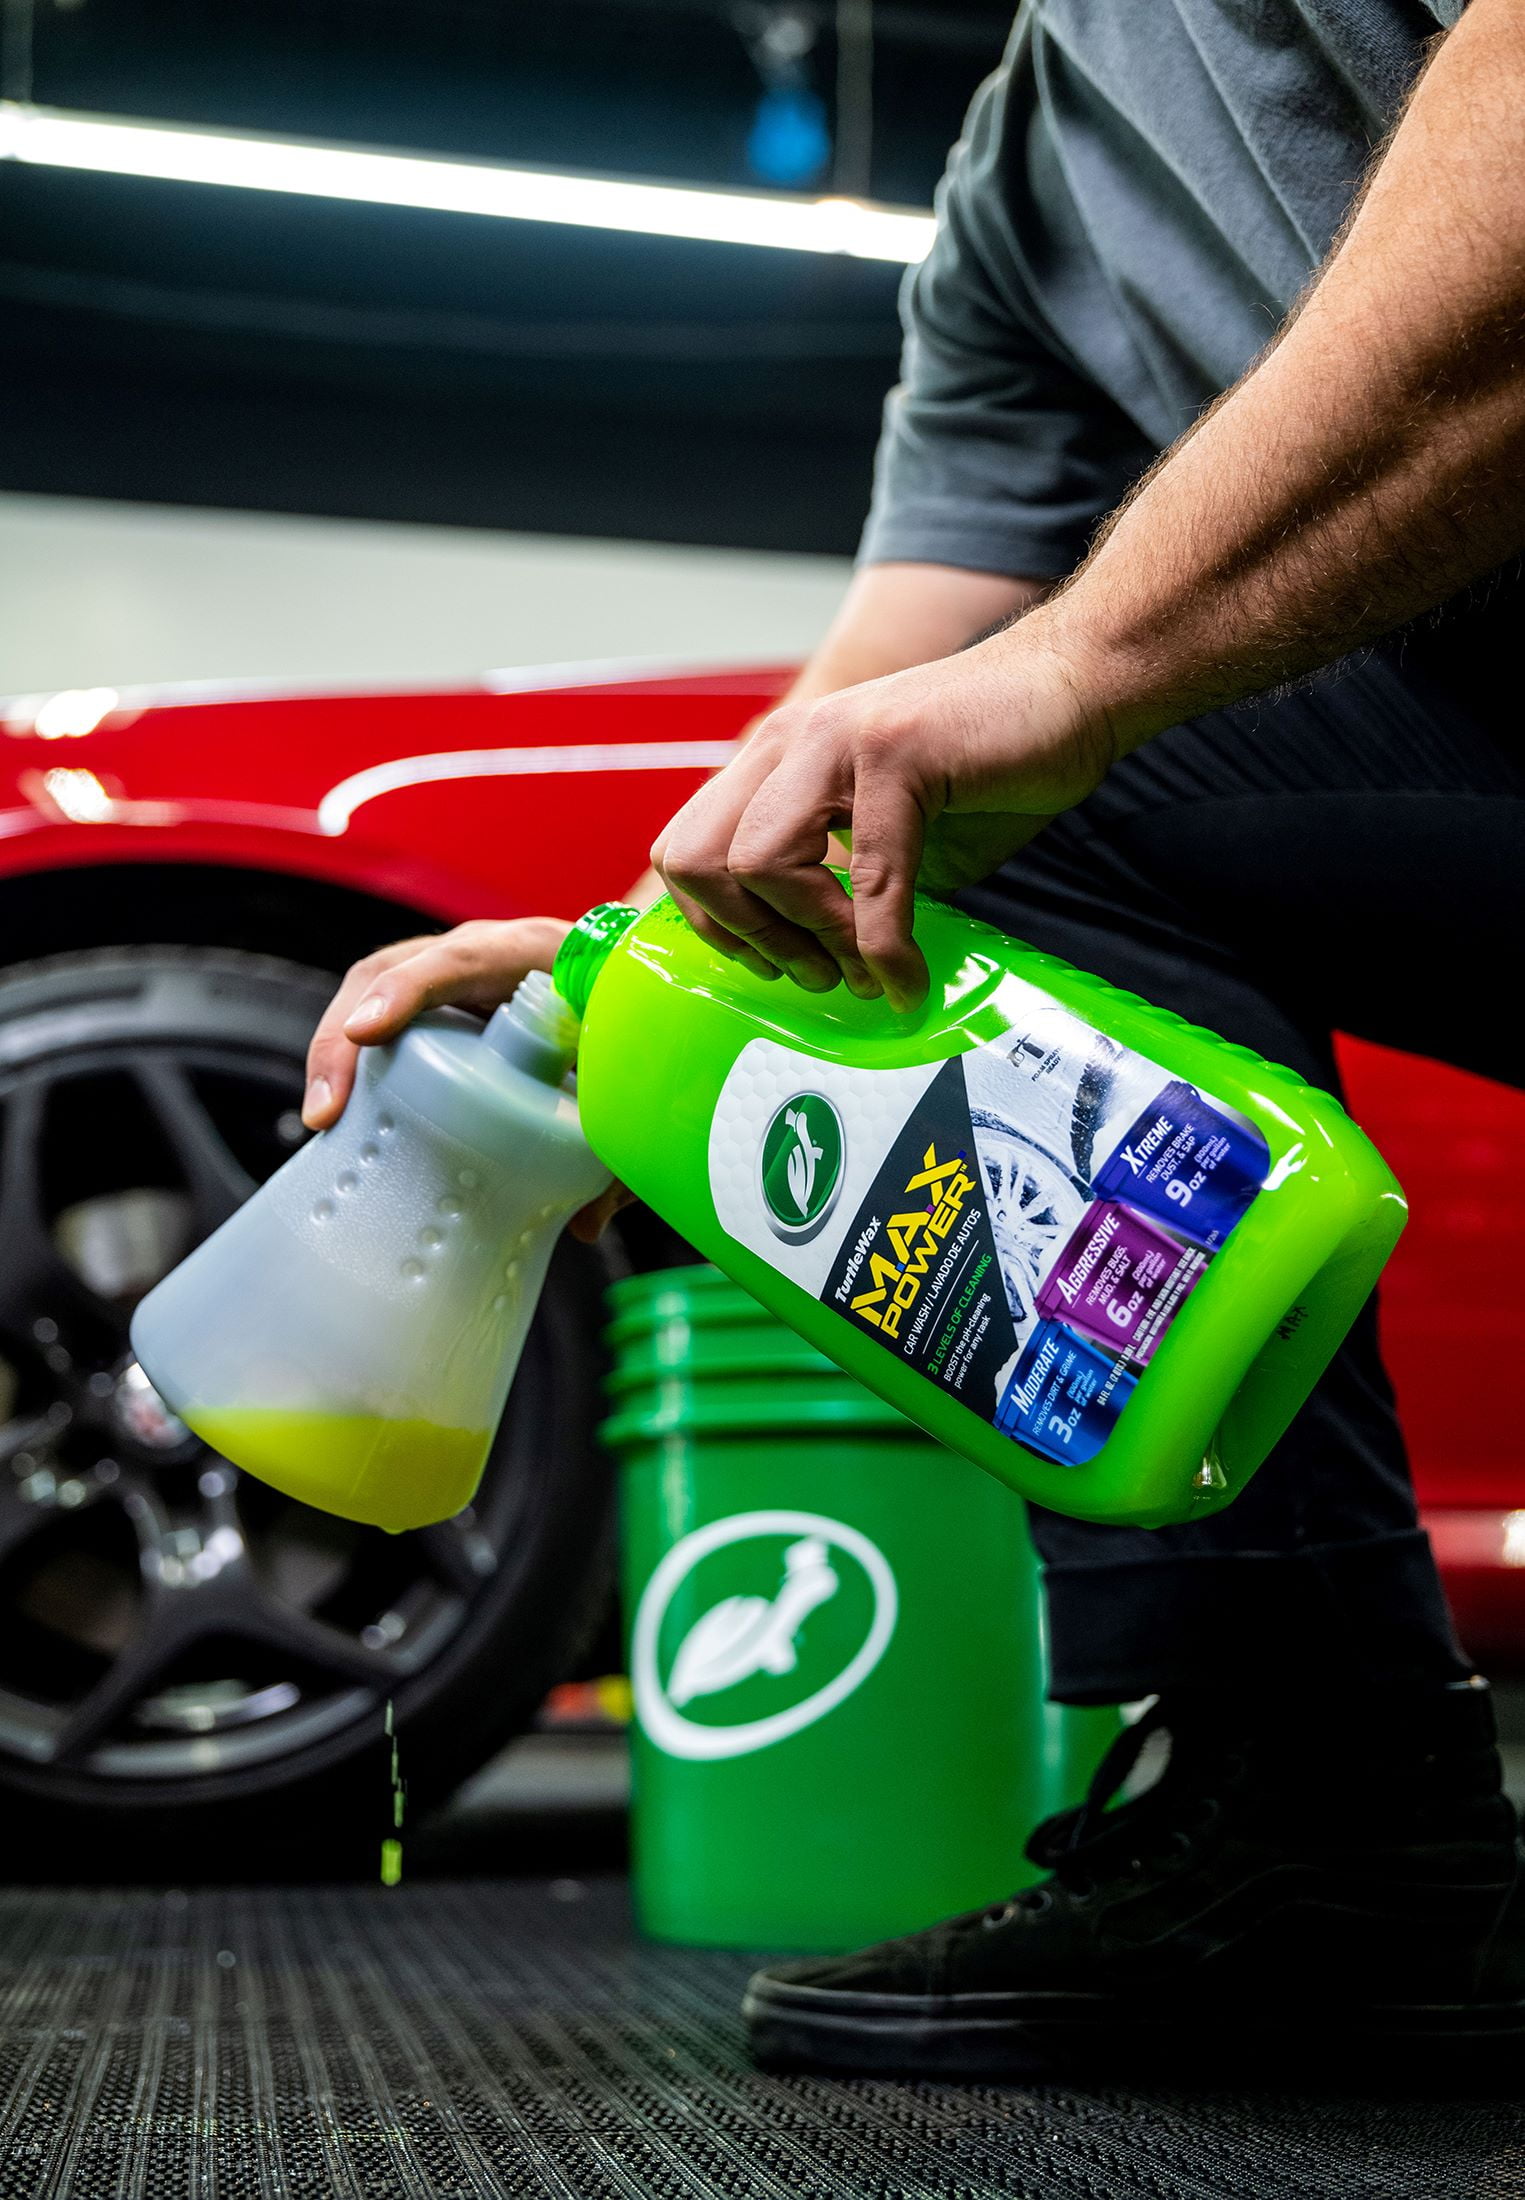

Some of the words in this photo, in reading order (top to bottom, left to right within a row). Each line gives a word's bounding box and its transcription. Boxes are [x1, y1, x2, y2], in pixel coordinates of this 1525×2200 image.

[1045, 1056, 1061, 1074] READY
[1119, 1115, 1173, 1175] XTREME
[1145, 1146, 1176, 1184] REMOVES
[1171, 1122, 1195, 1149] BRAKE
[1181, 1135, 1196, 1153] SAP
[1200, 1155, 1213, 1169] per
[1209, 1136, 1227, 1158] gallon
[1214, 1142, 1231, 1162] water
[1056, 1212, 1120, 1305] AGGRESSIVE
[1114, 1254, 1131, 1277] SALT
[1138, 1272, 1150, 1288] per
[1145, 1252, 1162, 1275] gallon
[1151, 1258, 1166, 1279] water
[903, 1333, 919, 1355] CAR
[911, 1303, 932, 1334] WASH
[927, 1257, 954, 1300] LAVADO
[947, 1242, 962, 1260] DE
[956, 1208, 981, 1246] AUTOS
[1085, 1266, 1113, 1306] REMOVES
[1107, 1245, 1128, 1270] BUGS,
[927, 1362, 939, 1375] 3
[933, 1323, 957, 1365] LEVELS
[950, 1307, 963, 1325] OF
[958, 1253, 993, 1308] CLEANING
[976, 1315, 991, 1334] task
[943, 1352, 960, 1382] BOOST
[955, 1340, 967, 1355] the
[962, 1292, 992, 1343] pH-cleaning
[970, 1333, 983, 1350] any
[962, 1348, 974, 1363] for
[954, 1361, 968, 1390] power
[1010, 1337, 1060, 1416] MODERATE
[1080, 1369, 1094, 1392] gallon
[1085, 1378, 1097, 1398] water
[1032, 1399, 1053, 1436] REMOVES
[1047, 1380, 1061, 1402] DIRT
[1059, 1350, 1077, 1377] GRIME
